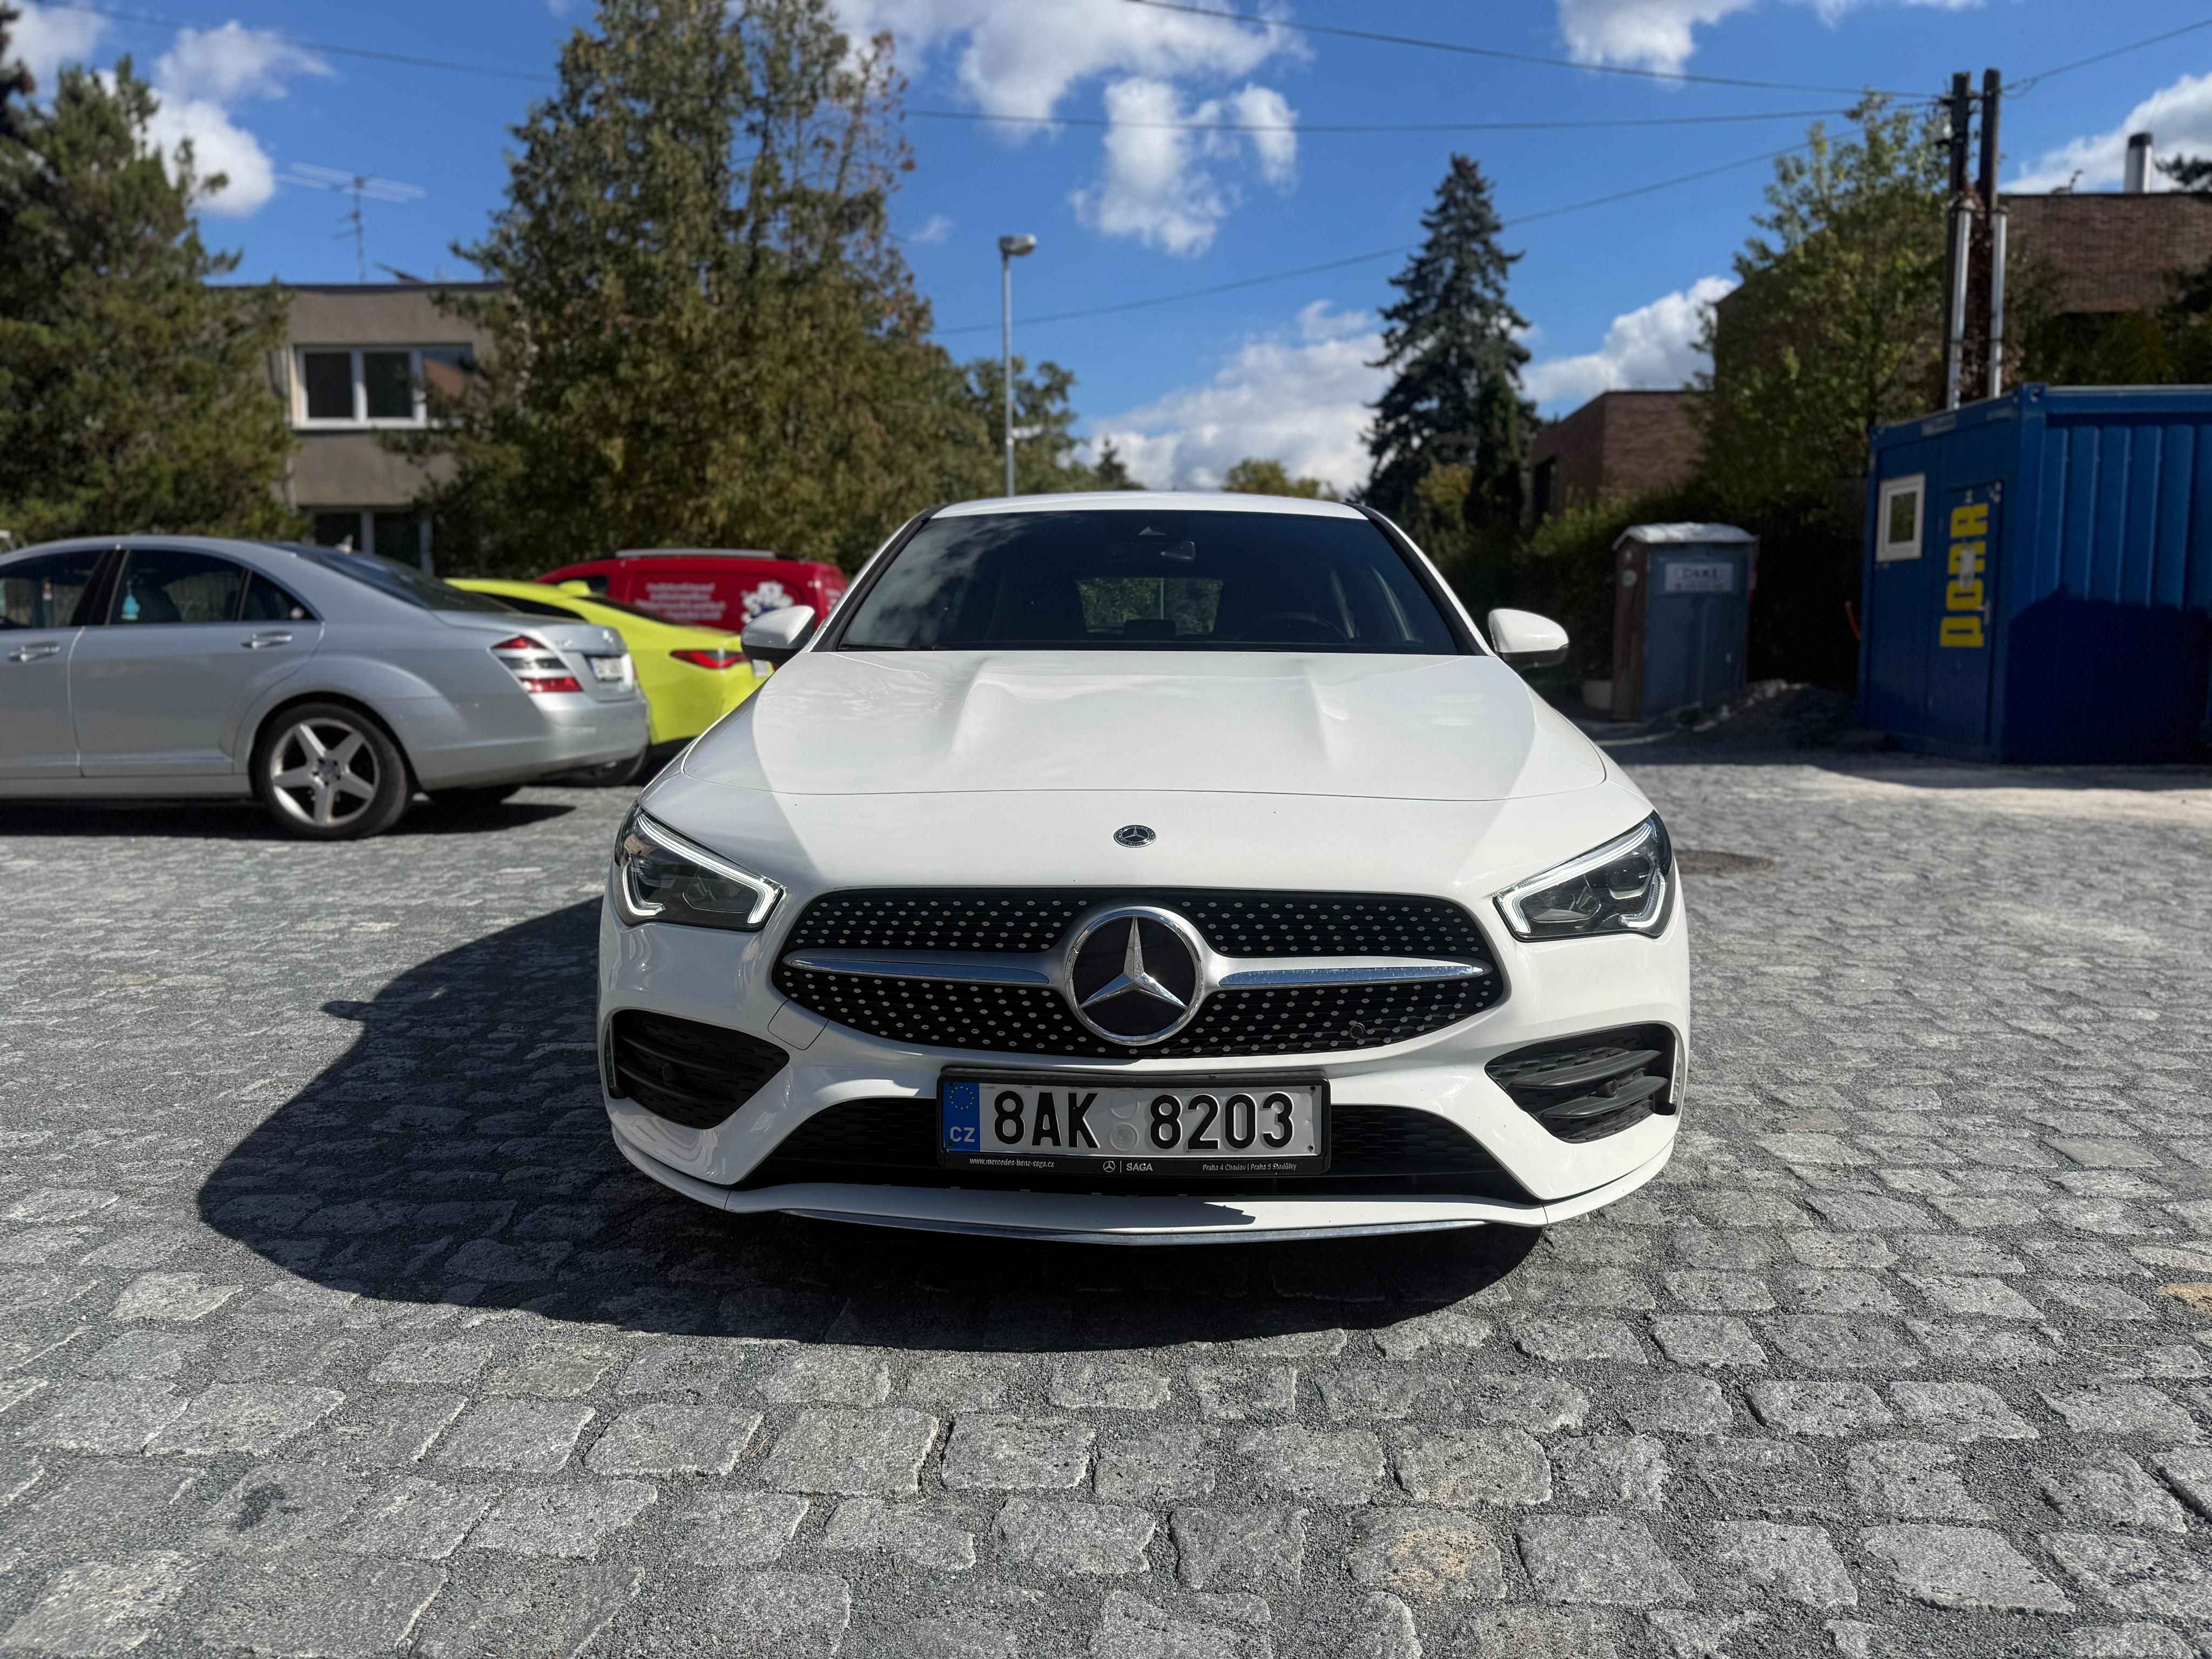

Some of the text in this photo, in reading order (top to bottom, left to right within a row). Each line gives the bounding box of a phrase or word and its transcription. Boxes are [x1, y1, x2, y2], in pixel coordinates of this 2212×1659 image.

[994, 1091, 1294, 1150] 8AK 8203
[950, 1127, 975, 1142] CZ
[969, 1158, 1055, 1168] www.mercedes-benz-saga.cz
[1126, 1162, 1153, 1171] SAGA
